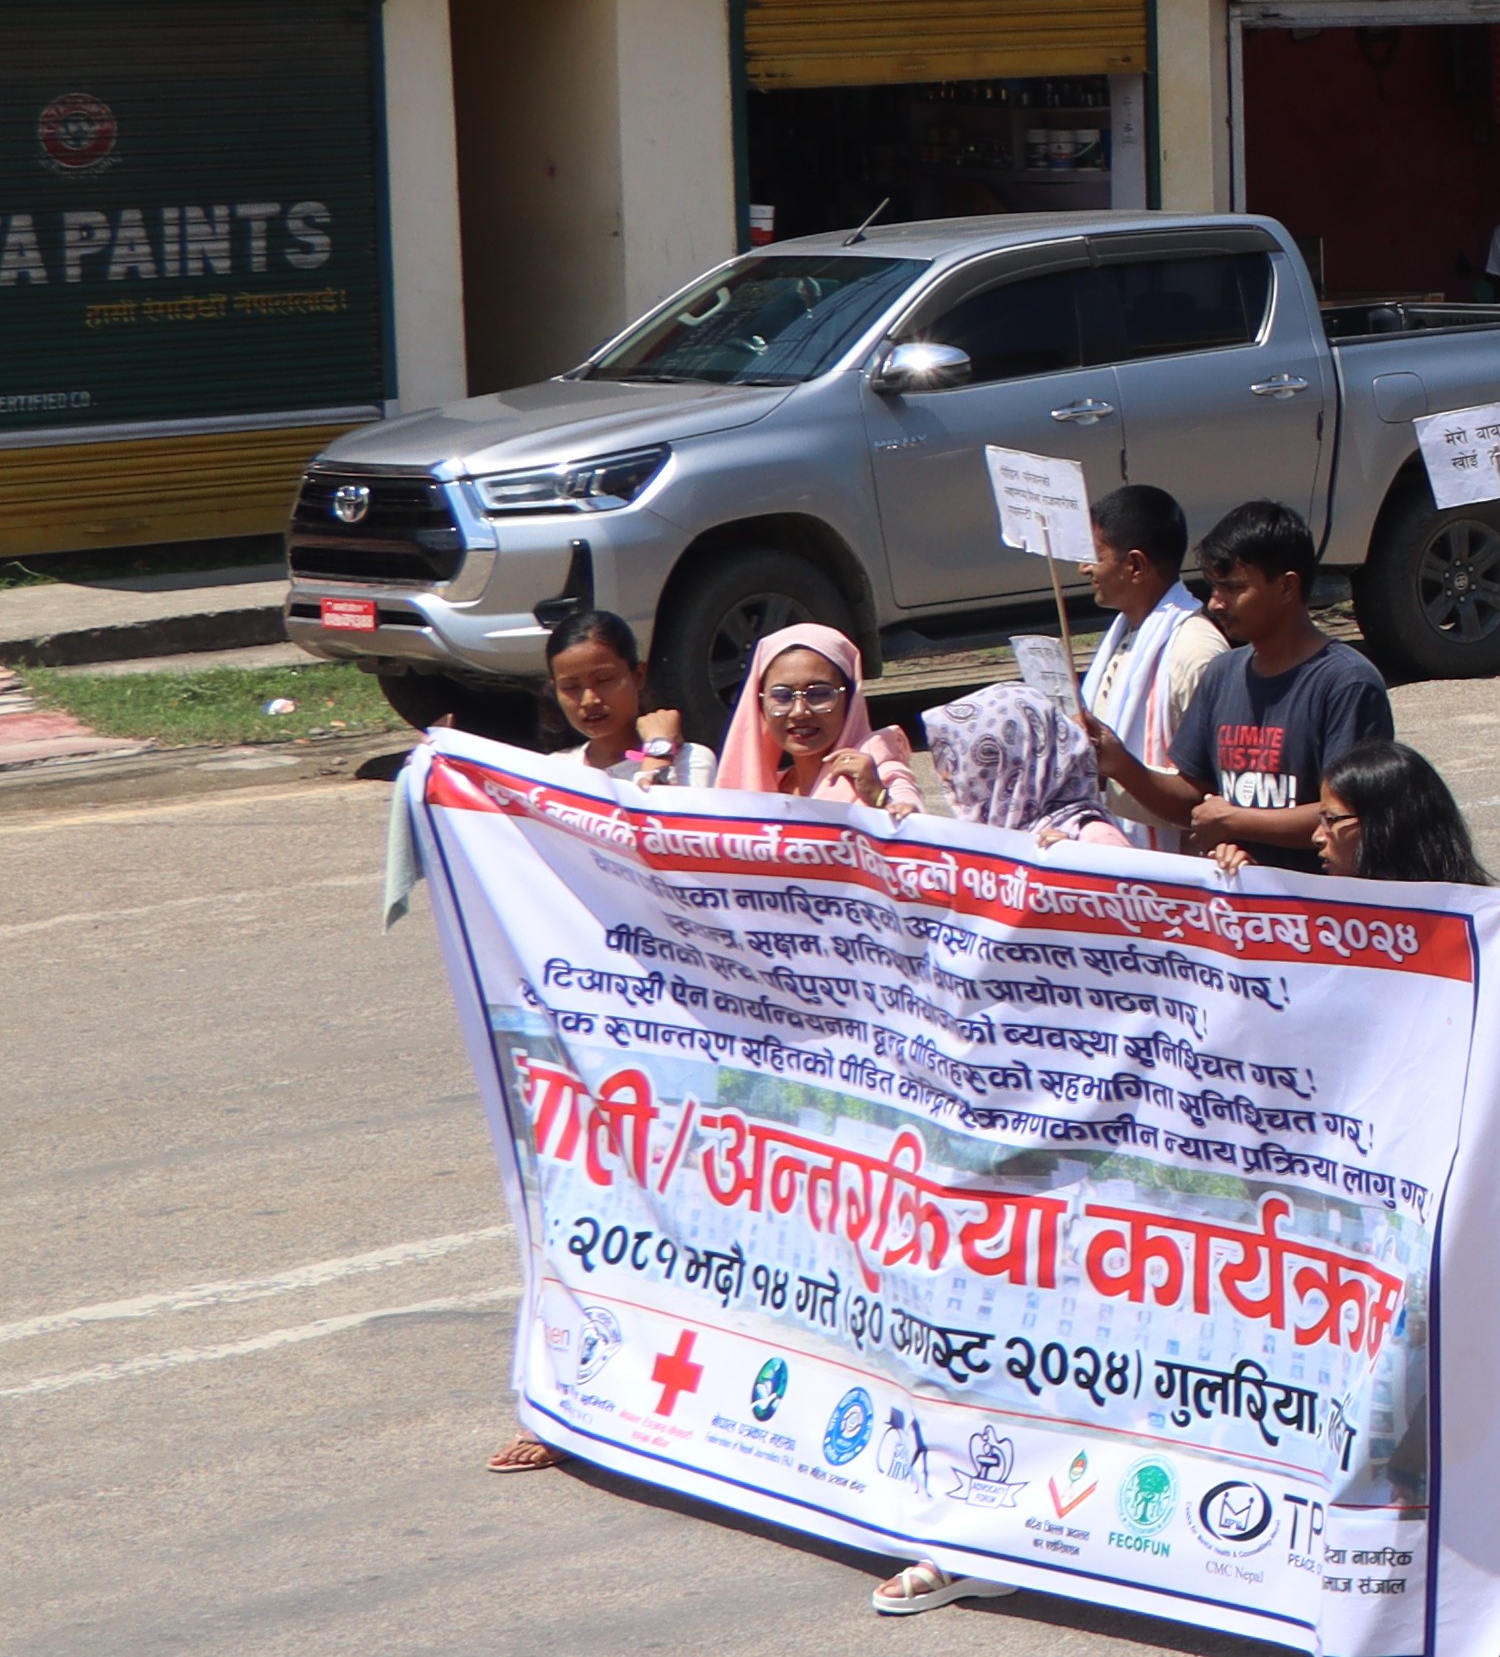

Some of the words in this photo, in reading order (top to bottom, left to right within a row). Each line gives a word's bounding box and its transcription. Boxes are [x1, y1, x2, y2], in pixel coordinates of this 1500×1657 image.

[62, 200, 333, 284] PAINTS
[0, 392, 68, 413] ERTIFIED
[1444, 426, 1467, 446] मेरो
[1217, 725, 1285, 748] CLIMATE
[1221, 771, 1297, 809] NOW!
[722, 823, 780, 864] पार्ने
[784, 829, 854, 870] कार्य
[965, 862, 998, 900] १४
[1210, 895, 1310, 955] दिवस
[1318, 914, 1420, 962] २०२४
[1084, 942, 1225, 992] सार्वजनिक
[981, 969, 1083, 1010] आयोग
[1090, 986, 1161, 1017] गठन
[670, 973, 710, 1011] ऐन
[1037, 1061, 1175, 1116] सहभागिता
[739, 1034, 835, 1081] सहितको
[838, 1051, 894, 1094] पीडित
[1164, 1134, 1238, 1166] न्याय
[1241, 1139, 1339, 1186] प्रक्रिया
[1341, 1163, 1399, 1207] लागु
[698, 1110, 1070, 1294] अन्तरक्रिया
[567, 1215, 678, 1282] २०८१
[752, 1261, 790, 1310] १४
[795, 1266, 841, 1328] गते
[1006, 1335, 1144, 1408] २०२४)
[1154, 1359, 1326, 1447] गुलरिया,
[1108, 1530, 1172, 1560] FECOFUN
[1351, 1542, 1414, 1568] नागरिक
[1204, 1559, 1233, 1579] CMC
[1235, 1564, 1265, 1585] Nepal
[1358, 1573, 1407, 1596] संजाल
